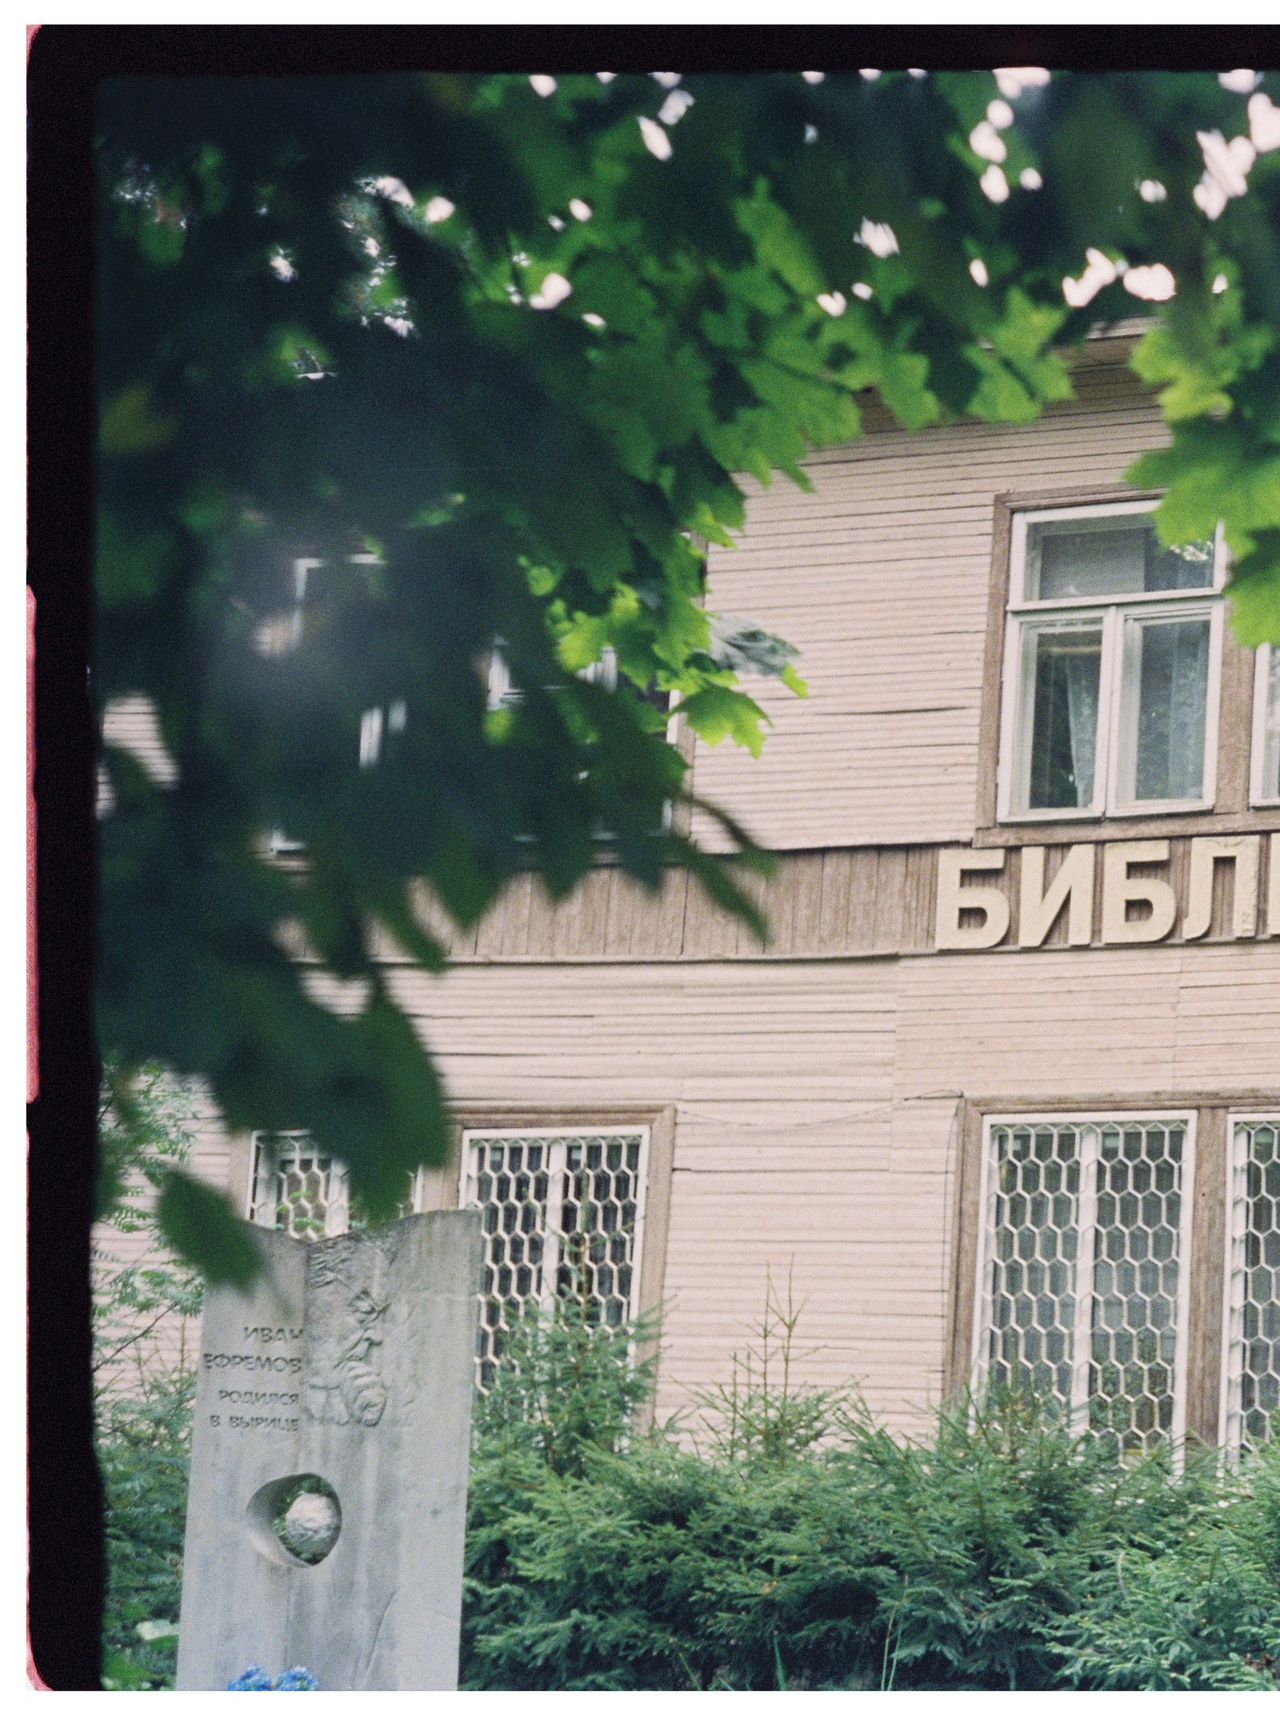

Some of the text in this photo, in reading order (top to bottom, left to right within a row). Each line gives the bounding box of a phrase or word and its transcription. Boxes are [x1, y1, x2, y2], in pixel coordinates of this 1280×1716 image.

[244, 1326, 304, 1343] ИВАН
[203, 1353, 302, 1374] ЕФРЕМОВ
[219, 1390, 299, 1406] РОДИЛСЯ
[210, 1415, 299, 1432] В ВЫРИЦЕ
